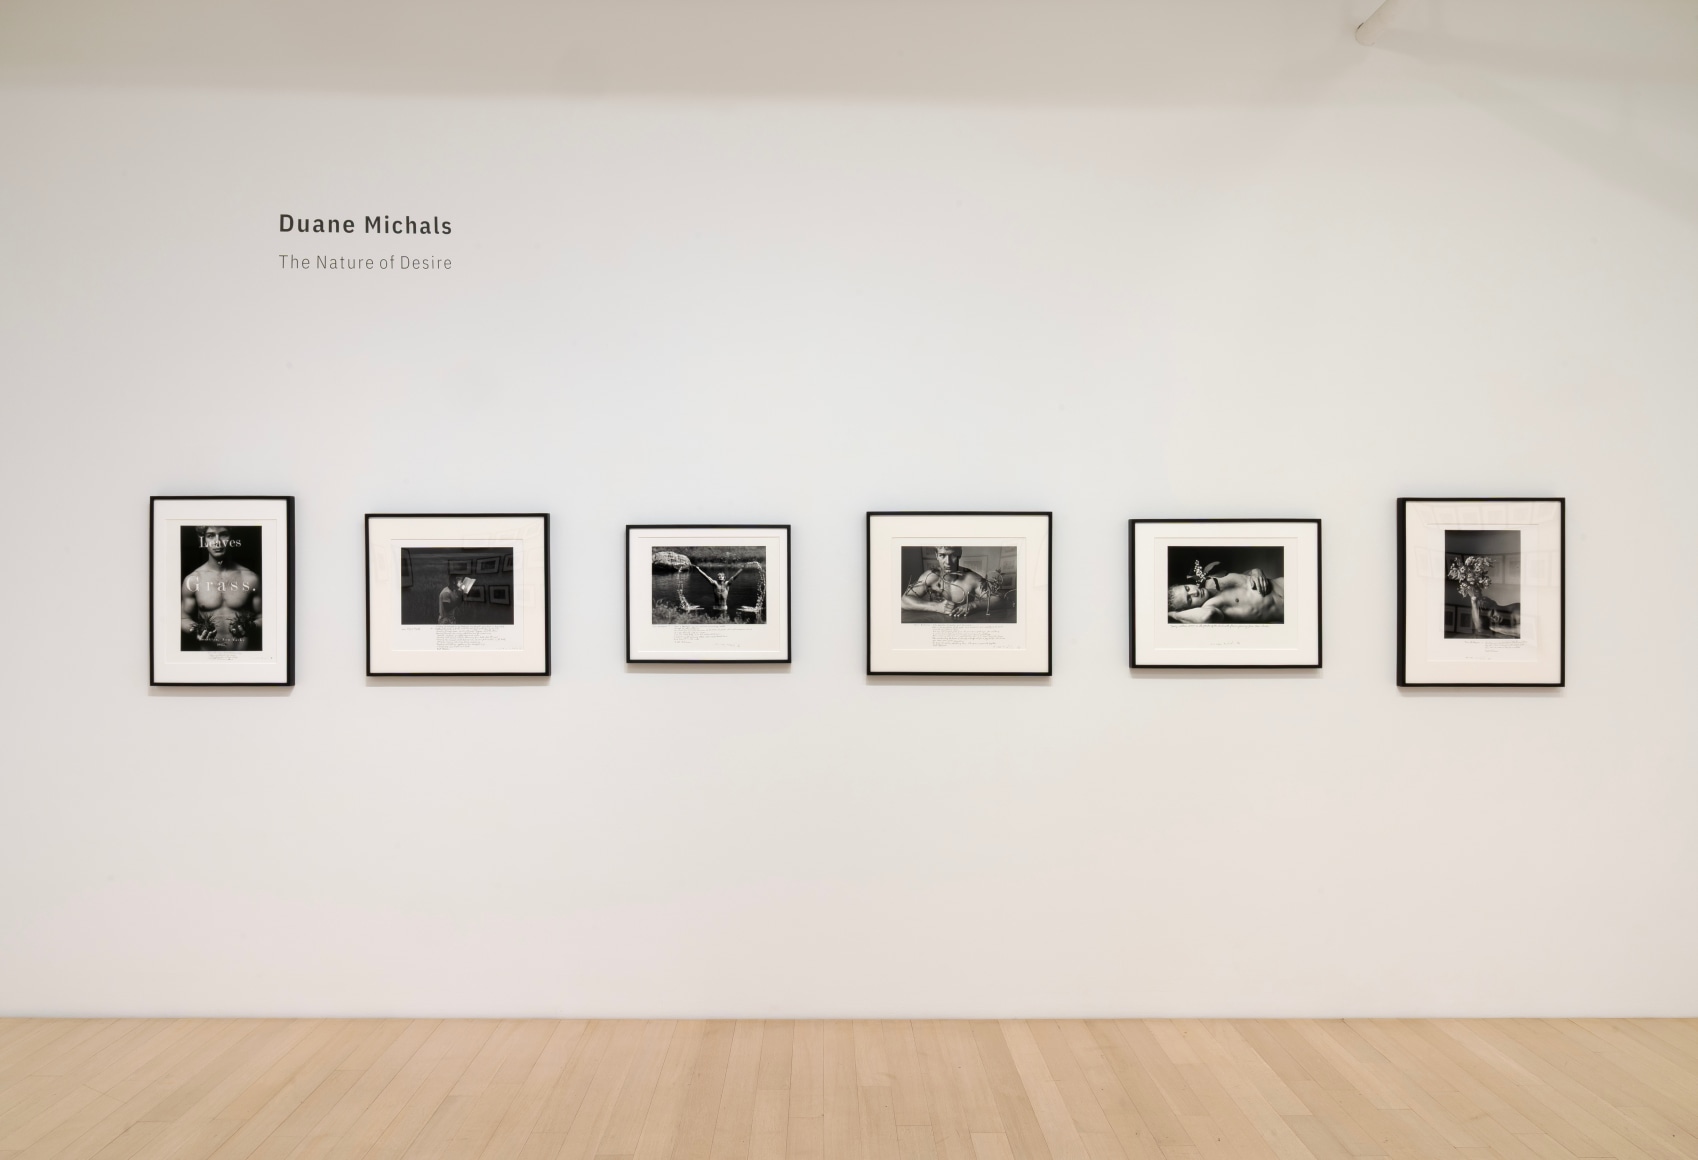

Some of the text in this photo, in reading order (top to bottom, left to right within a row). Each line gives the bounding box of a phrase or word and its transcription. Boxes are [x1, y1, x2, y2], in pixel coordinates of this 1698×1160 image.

[279, 214, 452, 235] Duane Michals
[278, 254, 452, 270] The Nature of Desire
[199, 535, 242, 548] Leaves
[186, 575, 256, 592] Grass.
